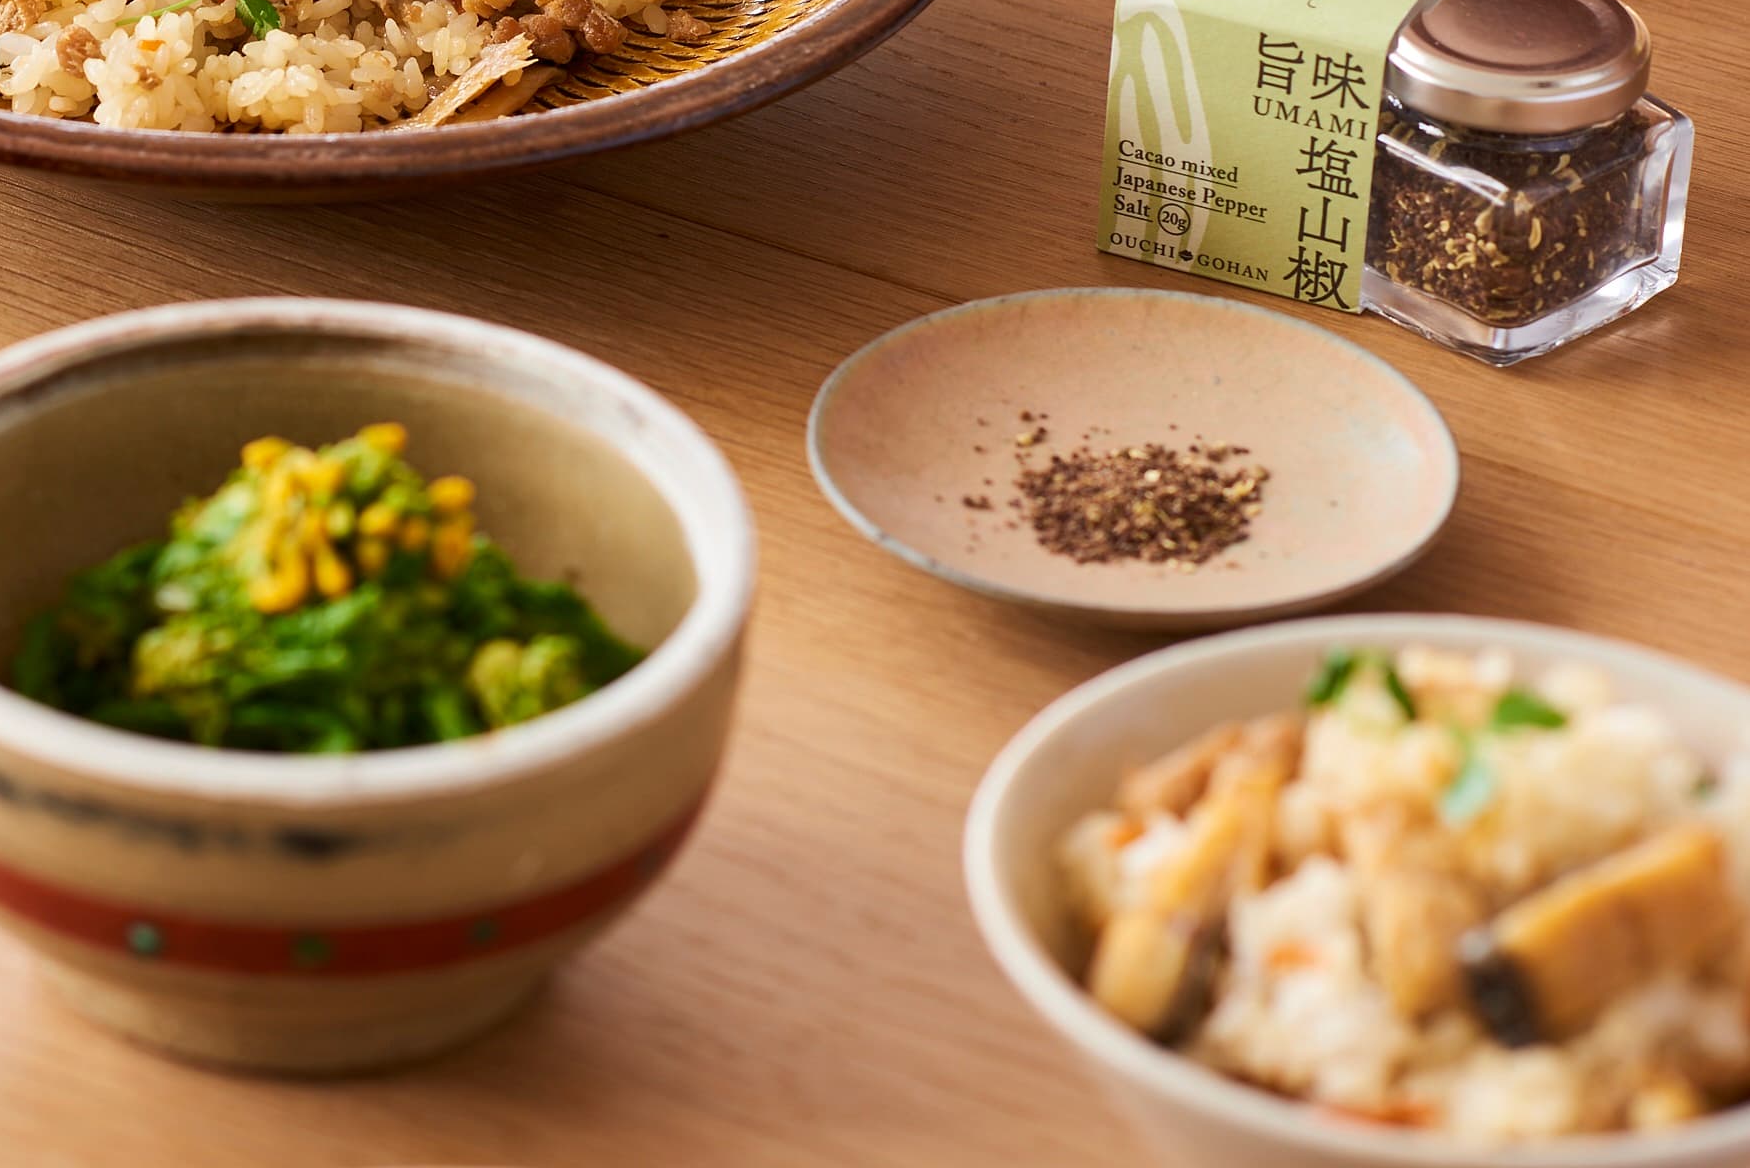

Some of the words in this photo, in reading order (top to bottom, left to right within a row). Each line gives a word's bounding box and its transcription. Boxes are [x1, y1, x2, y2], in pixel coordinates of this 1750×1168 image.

[1256, 32, 1370, 109] 旨味
[1252, 95, 1369, 141] UMAMI
[1119, 139, 1176, 167] Cacao
[1181, 160, 1238, 183] mixed
[1113, 166, 1197, 200] Japanese
[1202, 187, 1268, 218] Pepper
[1113, 194, 1151, 217] Salt
[1161, 210, 1188, 232] 20g
[1283, 135, 1359, 310] 塩山椒
[1110, 232, 1175, 258] OUCHI
[1197, 254, 1269, 282] GOHAN
